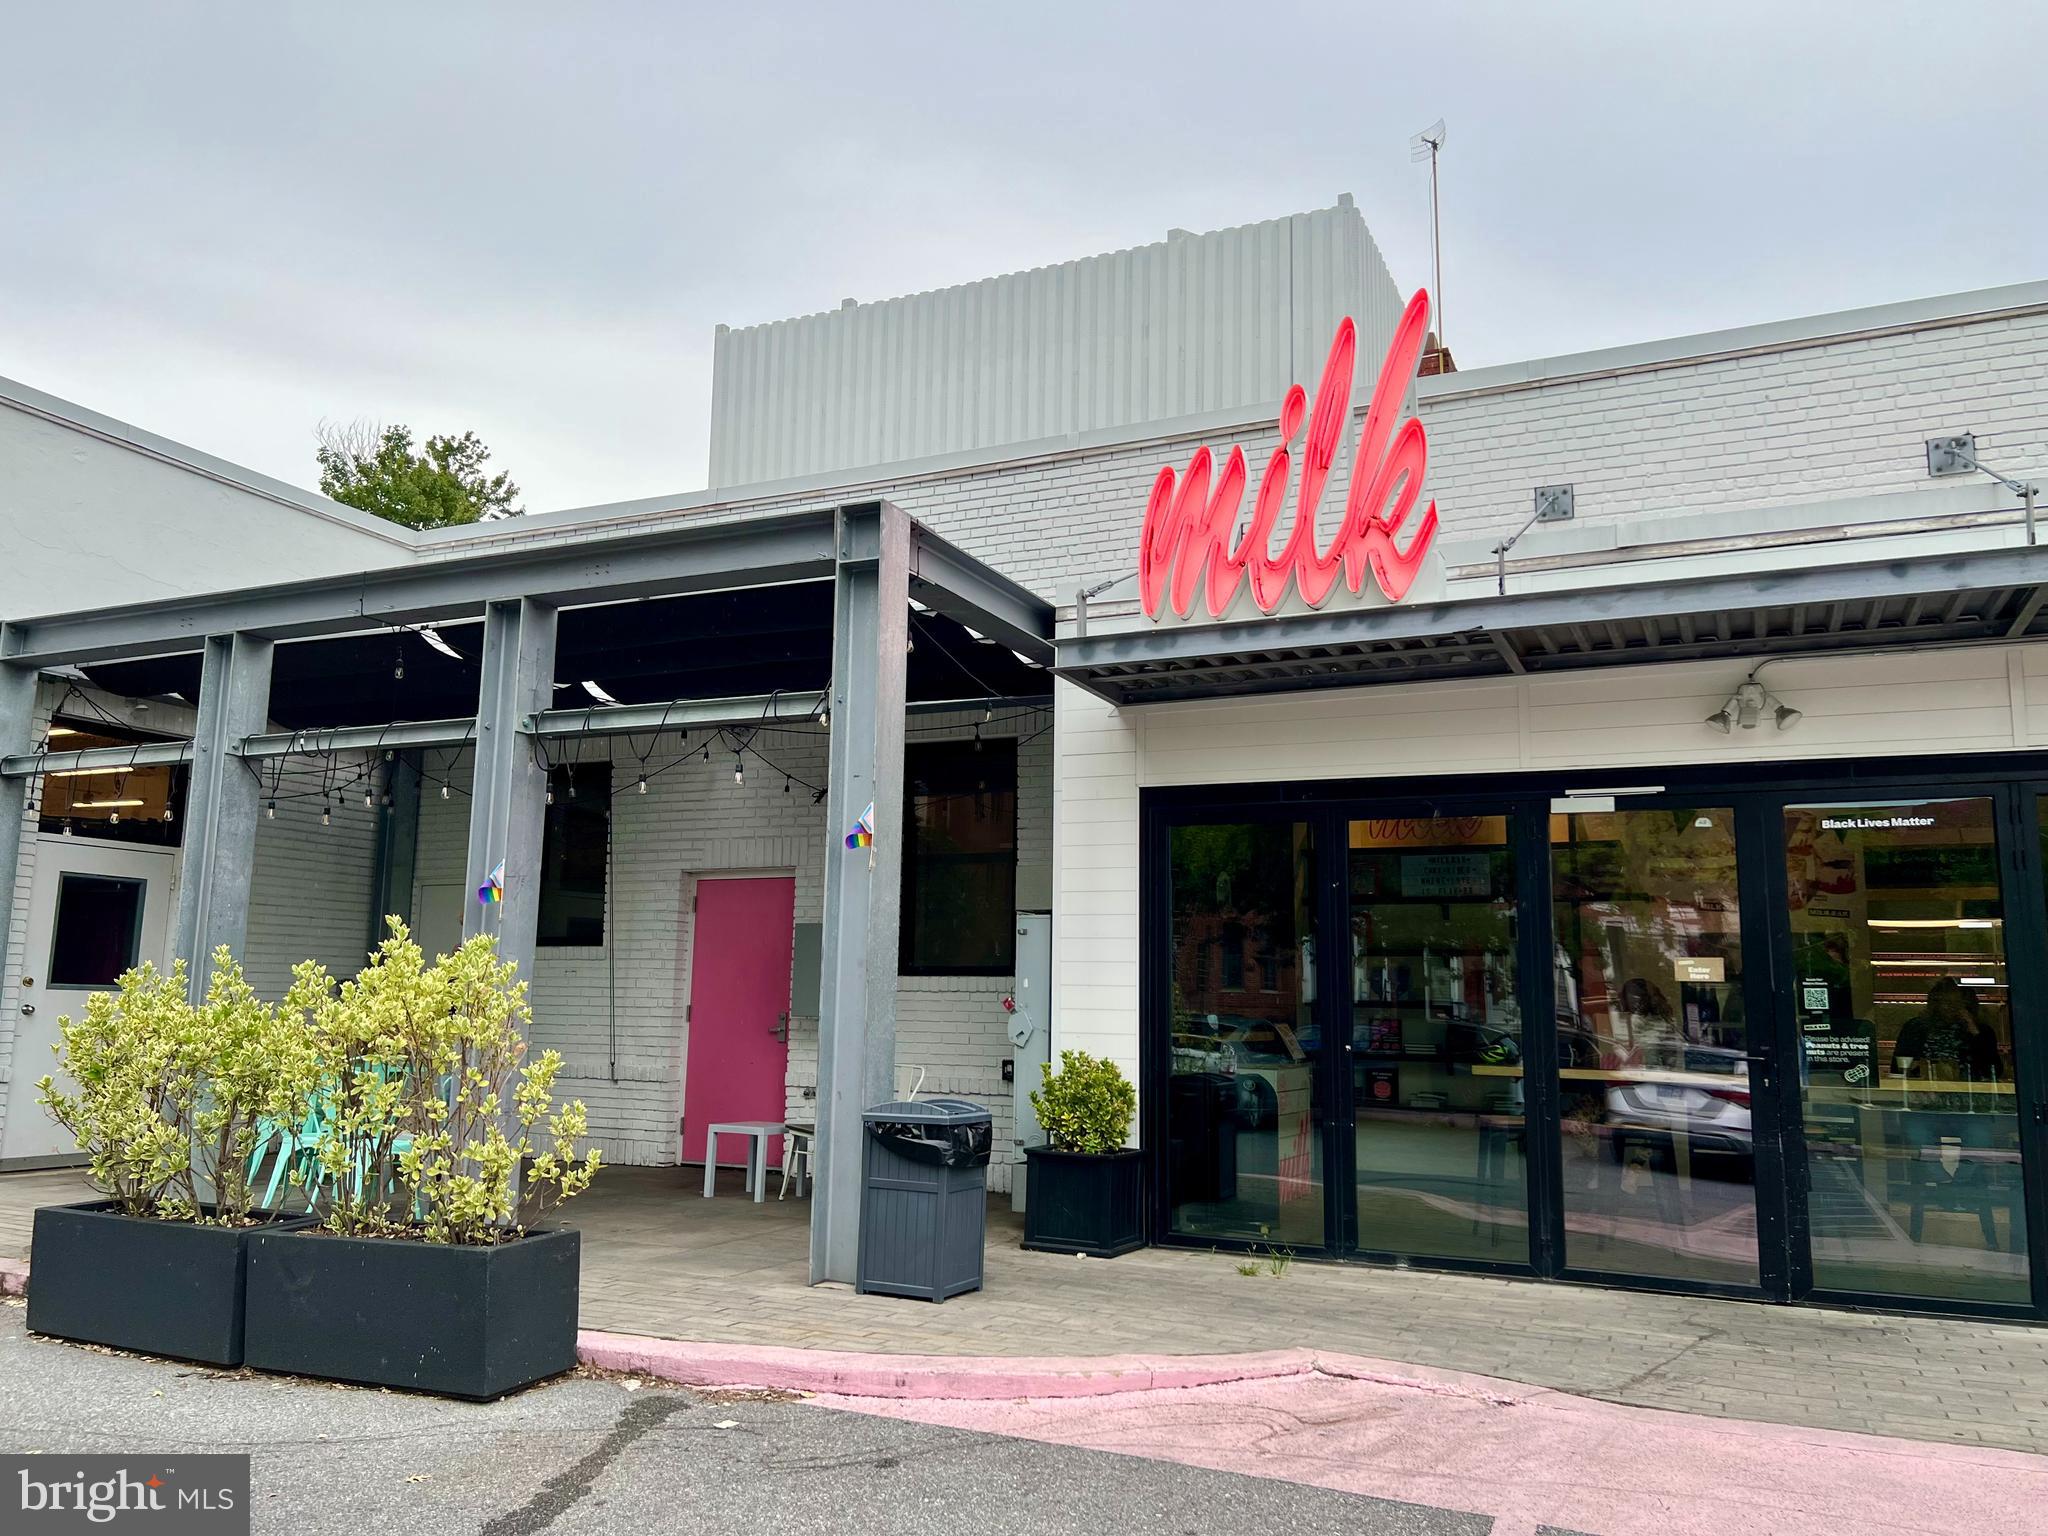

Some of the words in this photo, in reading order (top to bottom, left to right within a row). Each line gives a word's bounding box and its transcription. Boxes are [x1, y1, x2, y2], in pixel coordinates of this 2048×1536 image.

[1138, 286, 1440, 622] milk
[1821, 819, 1856, 829] Black
[1857, 818, 1890, 828] Lives
[1891, 817, 1935, 827] Matter
